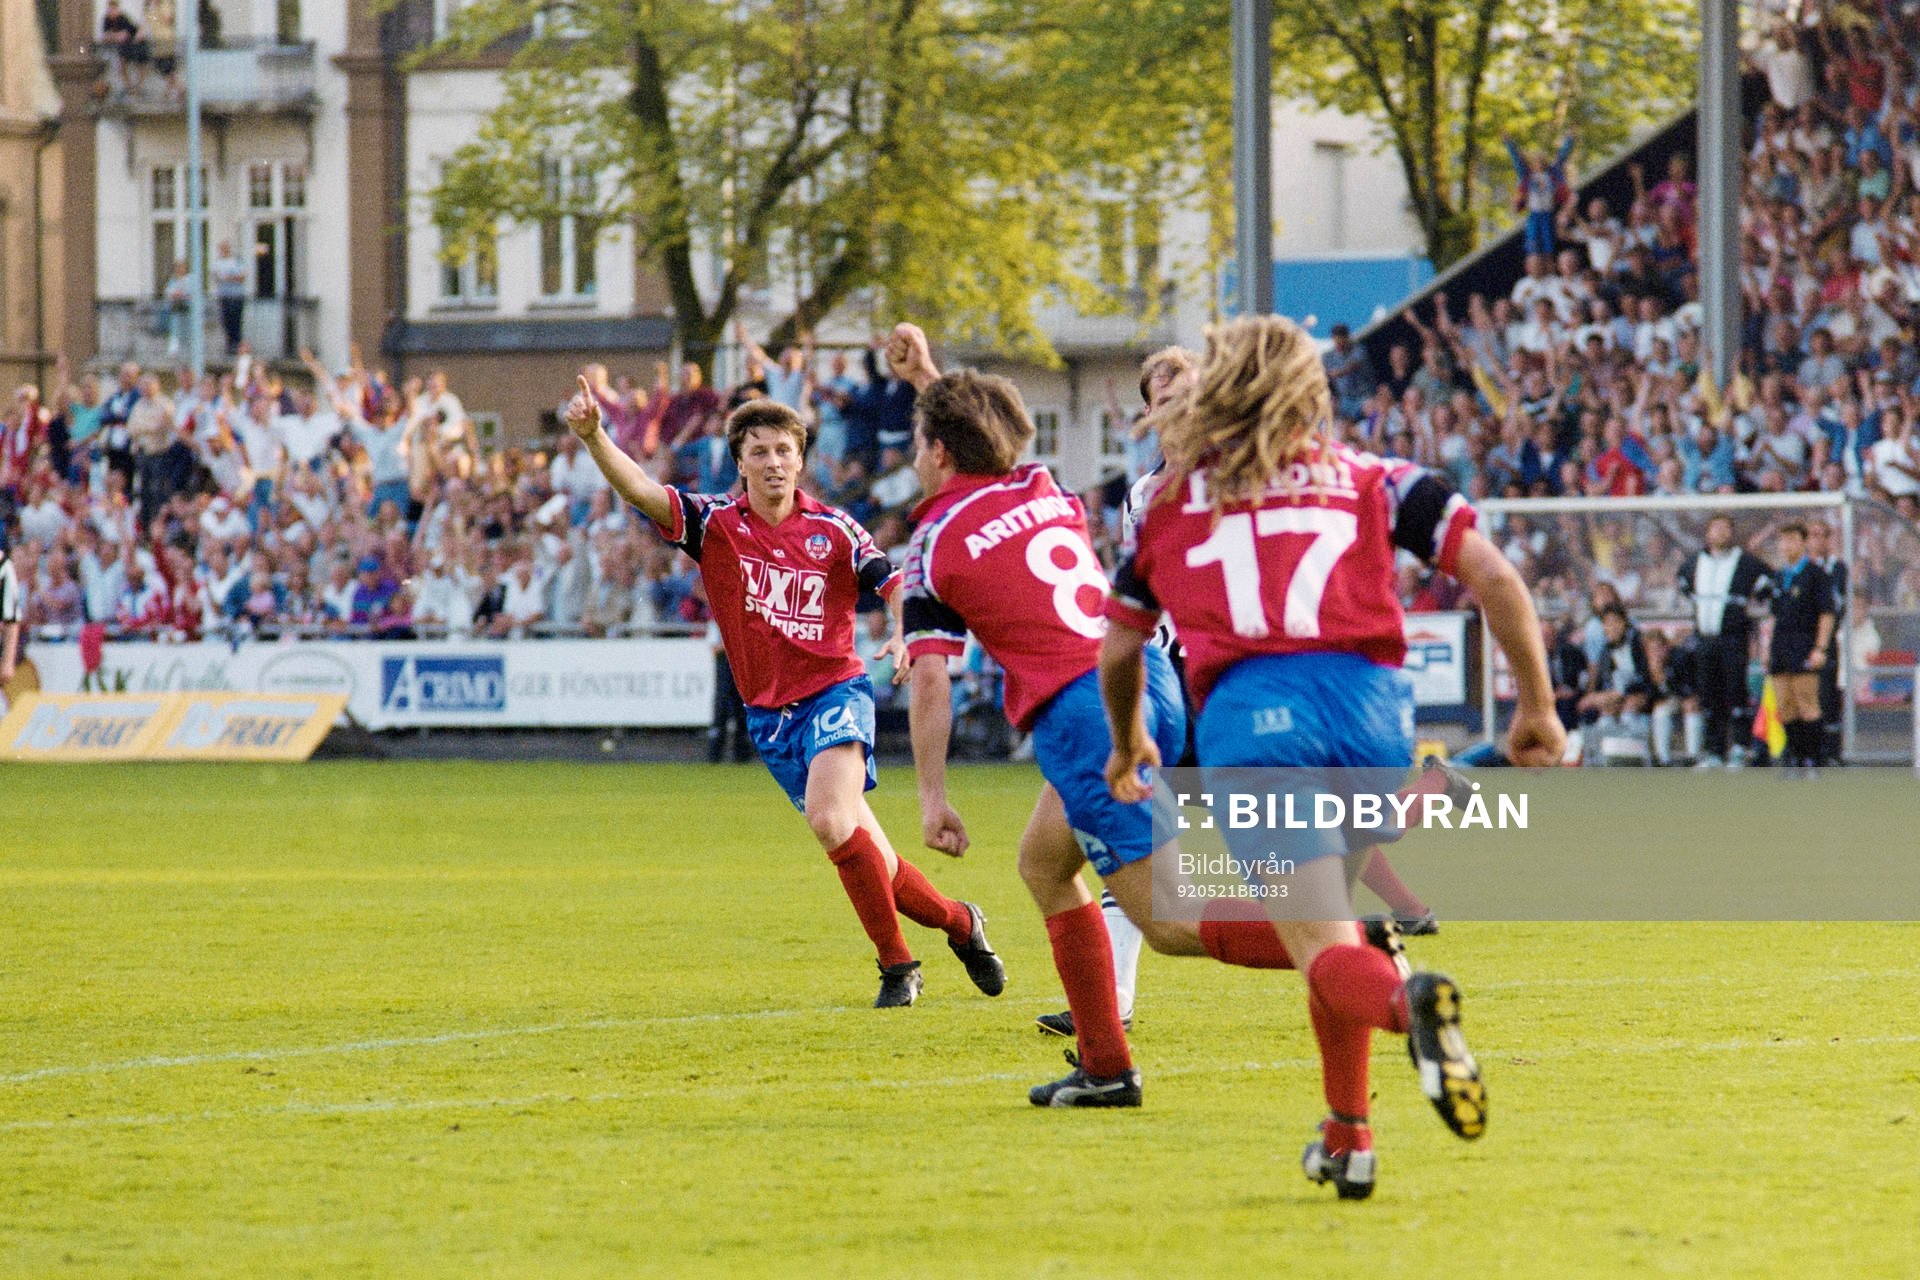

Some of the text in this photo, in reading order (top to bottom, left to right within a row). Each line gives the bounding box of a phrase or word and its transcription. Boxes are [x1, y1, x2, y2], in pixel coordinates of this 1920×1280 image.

[1025, 526, 1109, 639] 8
[1185, 506, 1357, 639] 17
[812, 706, 865, 740] ICA
